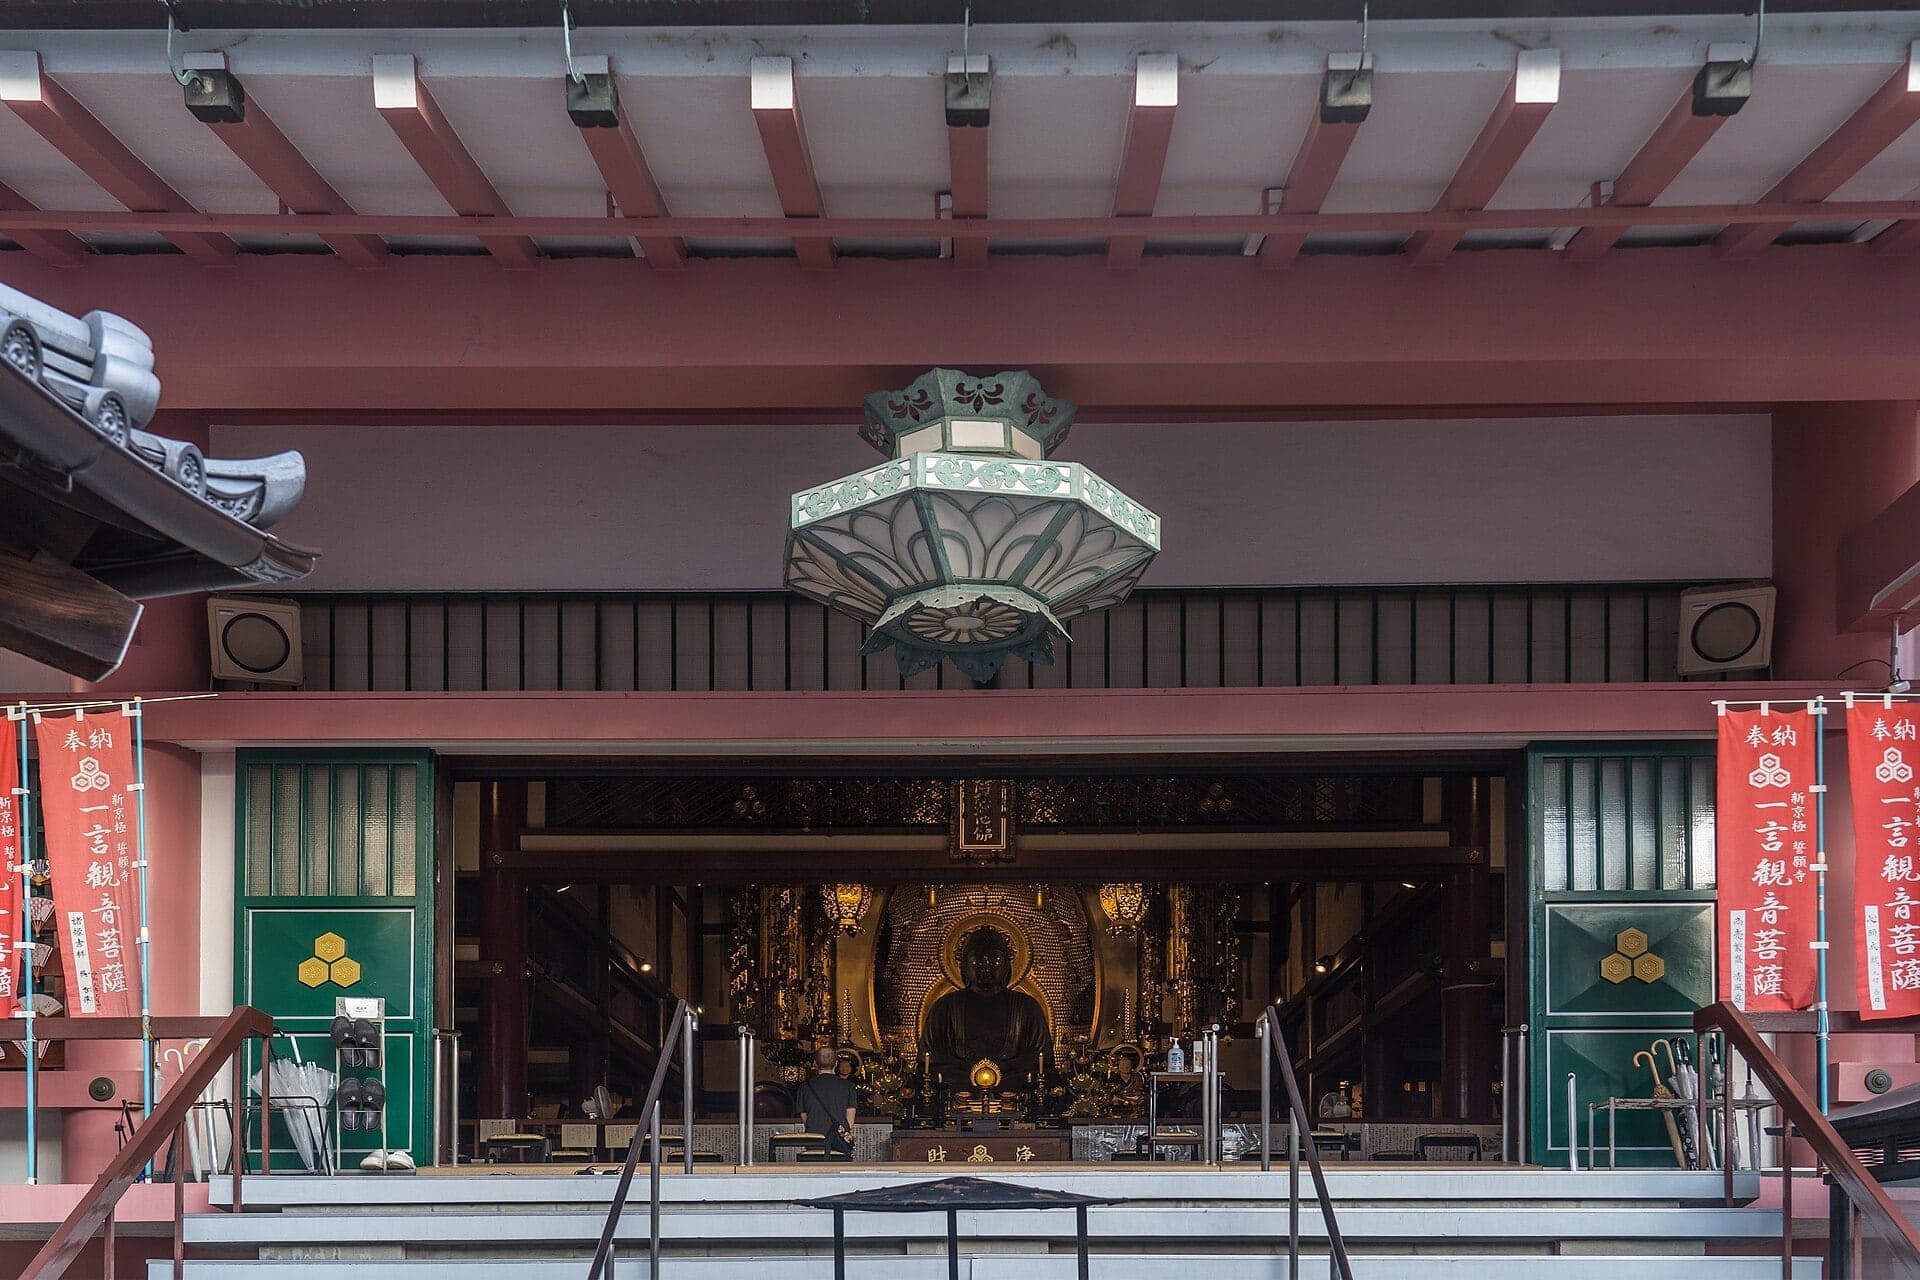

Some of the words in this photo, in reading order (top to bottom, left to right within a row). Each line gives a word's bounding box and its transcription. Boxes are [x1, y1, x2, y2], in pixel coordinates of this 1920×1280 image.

[62, 727, 113, 752] 奉納
[1744, 724, 1797, 748] 奉納
[1870, 717, 1916, 742] 奉納
[111, 793, 127, 834] 新京極
[1790, 792, 1807, 832] 新京極
[117, 842, 131, 882] 誓願寺
[1792, 841, 1807, 883] 誓願寺
[79, 804, 128, 994] 一言観音菩薩
[1752, 802, 1793, 996] 一言観音菩薩
[1880, 797, 1920, 992] 一言観音菩薩
[927, 1144, 947, 1162] 財
